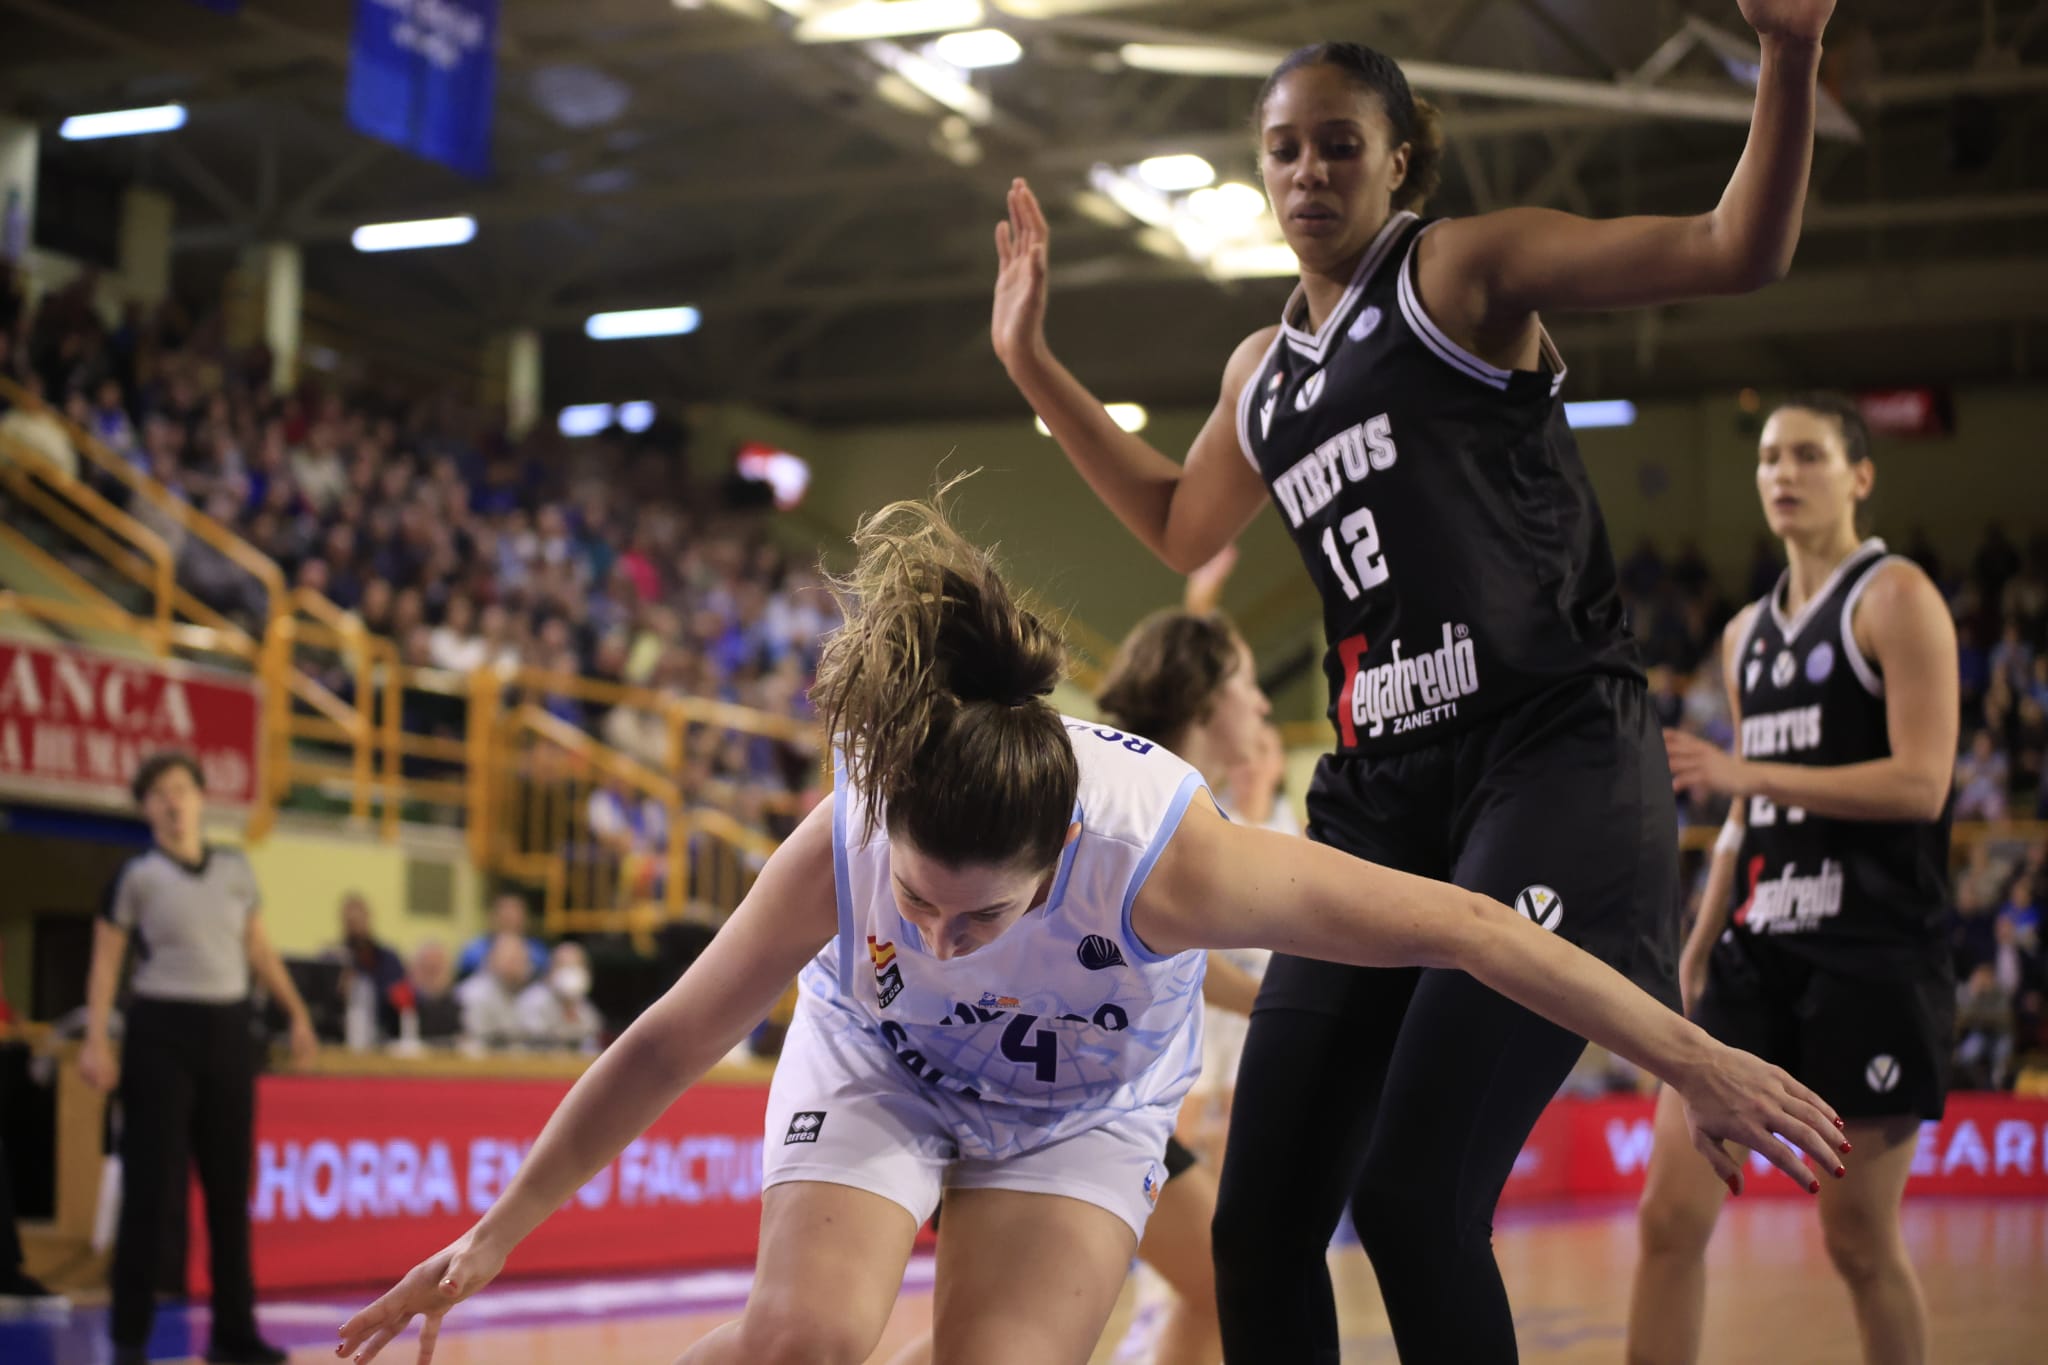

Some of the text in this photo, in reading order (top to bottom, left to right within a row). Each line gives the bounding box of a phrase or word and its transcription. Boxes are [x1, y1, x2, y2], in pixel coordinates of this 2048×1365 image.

[1272, 412, 1397, 529] VIRTUS
[1322, 506, 1390, 601] 12
[1393, 702, 1457, 735] ZANETTI
[1742, 704, 1821, 757] VIRTUS
[1001, 1013, 1058, 1083] 4
